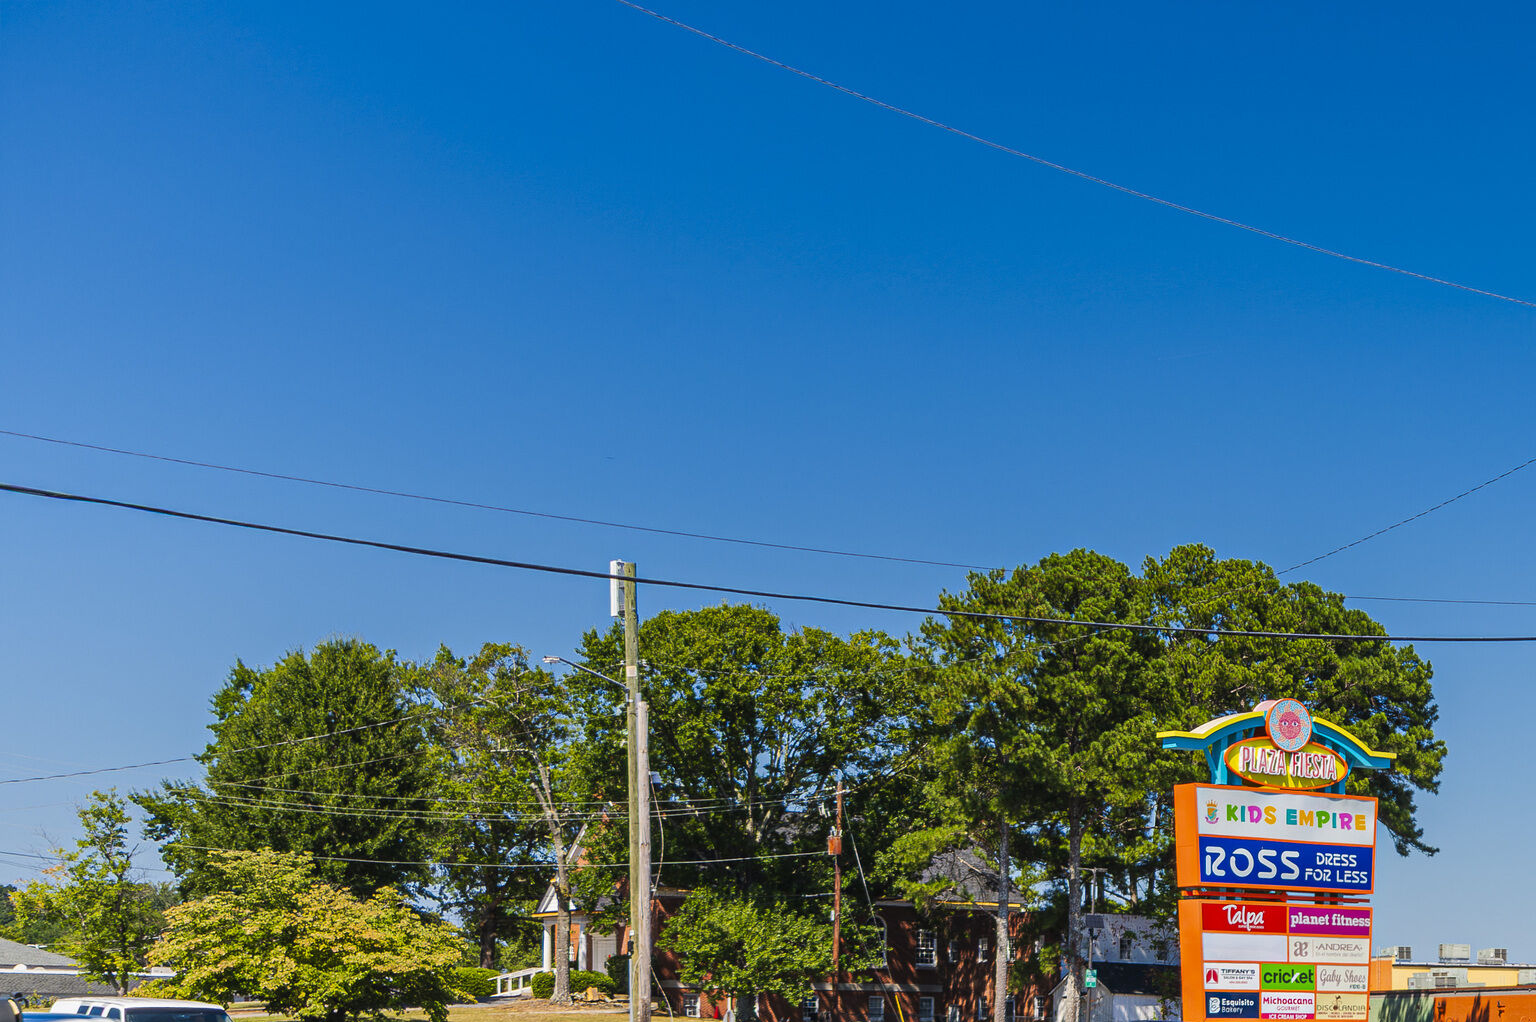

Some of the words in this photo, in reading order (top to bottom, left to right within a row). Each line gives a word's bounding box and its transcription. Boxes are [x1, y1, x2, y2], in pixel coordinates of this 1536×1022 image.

[1239, 746, 1287, 776] PLAZA
[1289, 752, 1338, 781] FIESTA
[1226, 804, 1277, 825] KIDS
[1285, 808, 1367, 831] EMPIRE
[1205, 846, 1300, 880] ROSS
[1316, 852, 1357, 868] DRESS
[1305, 868, 1331, 882] FOR
[1336, 870, 1368, 884] LESS
[1222, 904, 1265, 931] Talpa
[1290, 912, 1330, 928] planet
[1331, 913, 1371, 927] fitness
[1263, 968, 1314, 984] cricket
[1320, 968, 1342, 987] Gaby
[1343, 969, 1366, 983] Shoes
[1221, 998, 1255, 1007] Esquisito
[1263, 996, 1313, 1005] Michoacana
[1221, 1006, 1243, 1014] Bakery
